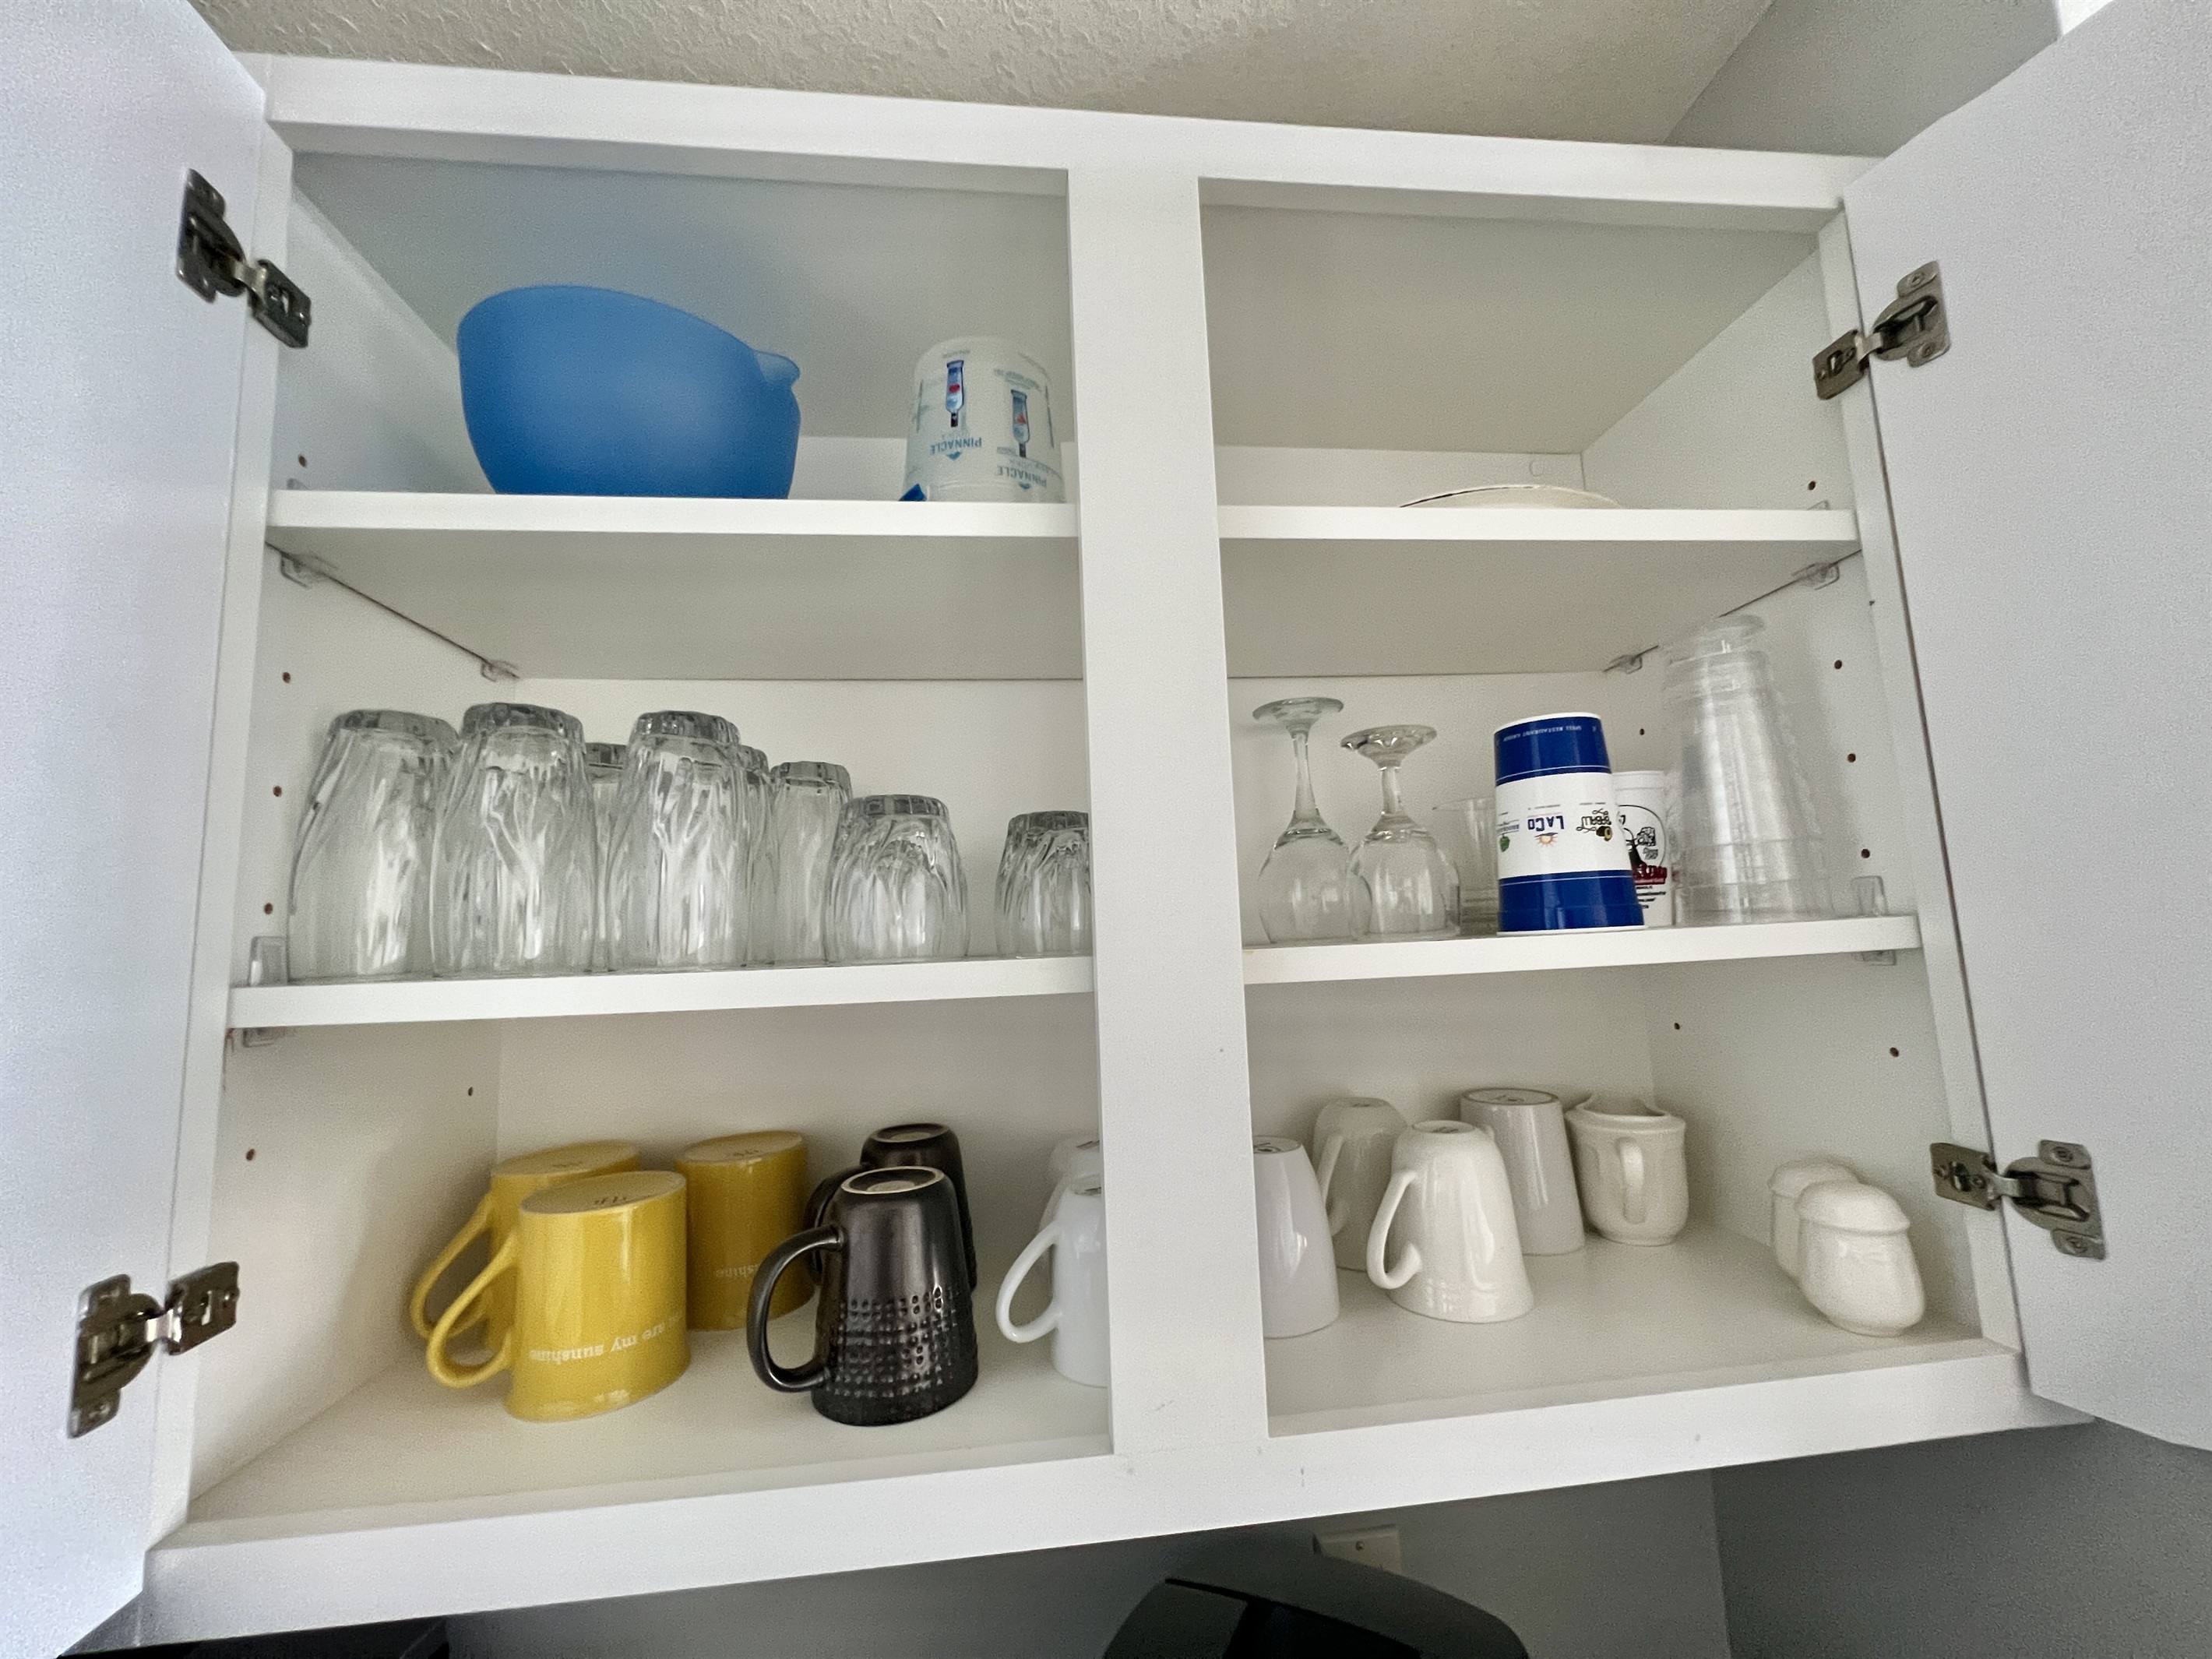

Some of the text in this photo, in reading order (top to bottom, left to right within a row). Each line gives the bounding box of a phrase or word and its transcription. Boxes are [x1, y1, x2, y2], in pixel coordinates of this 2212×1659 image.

[930, 437, 981, 454] PINNACLE
[997, 465, 1047, 488] PINNACLE
[611, 1335, 638, 1352] my
